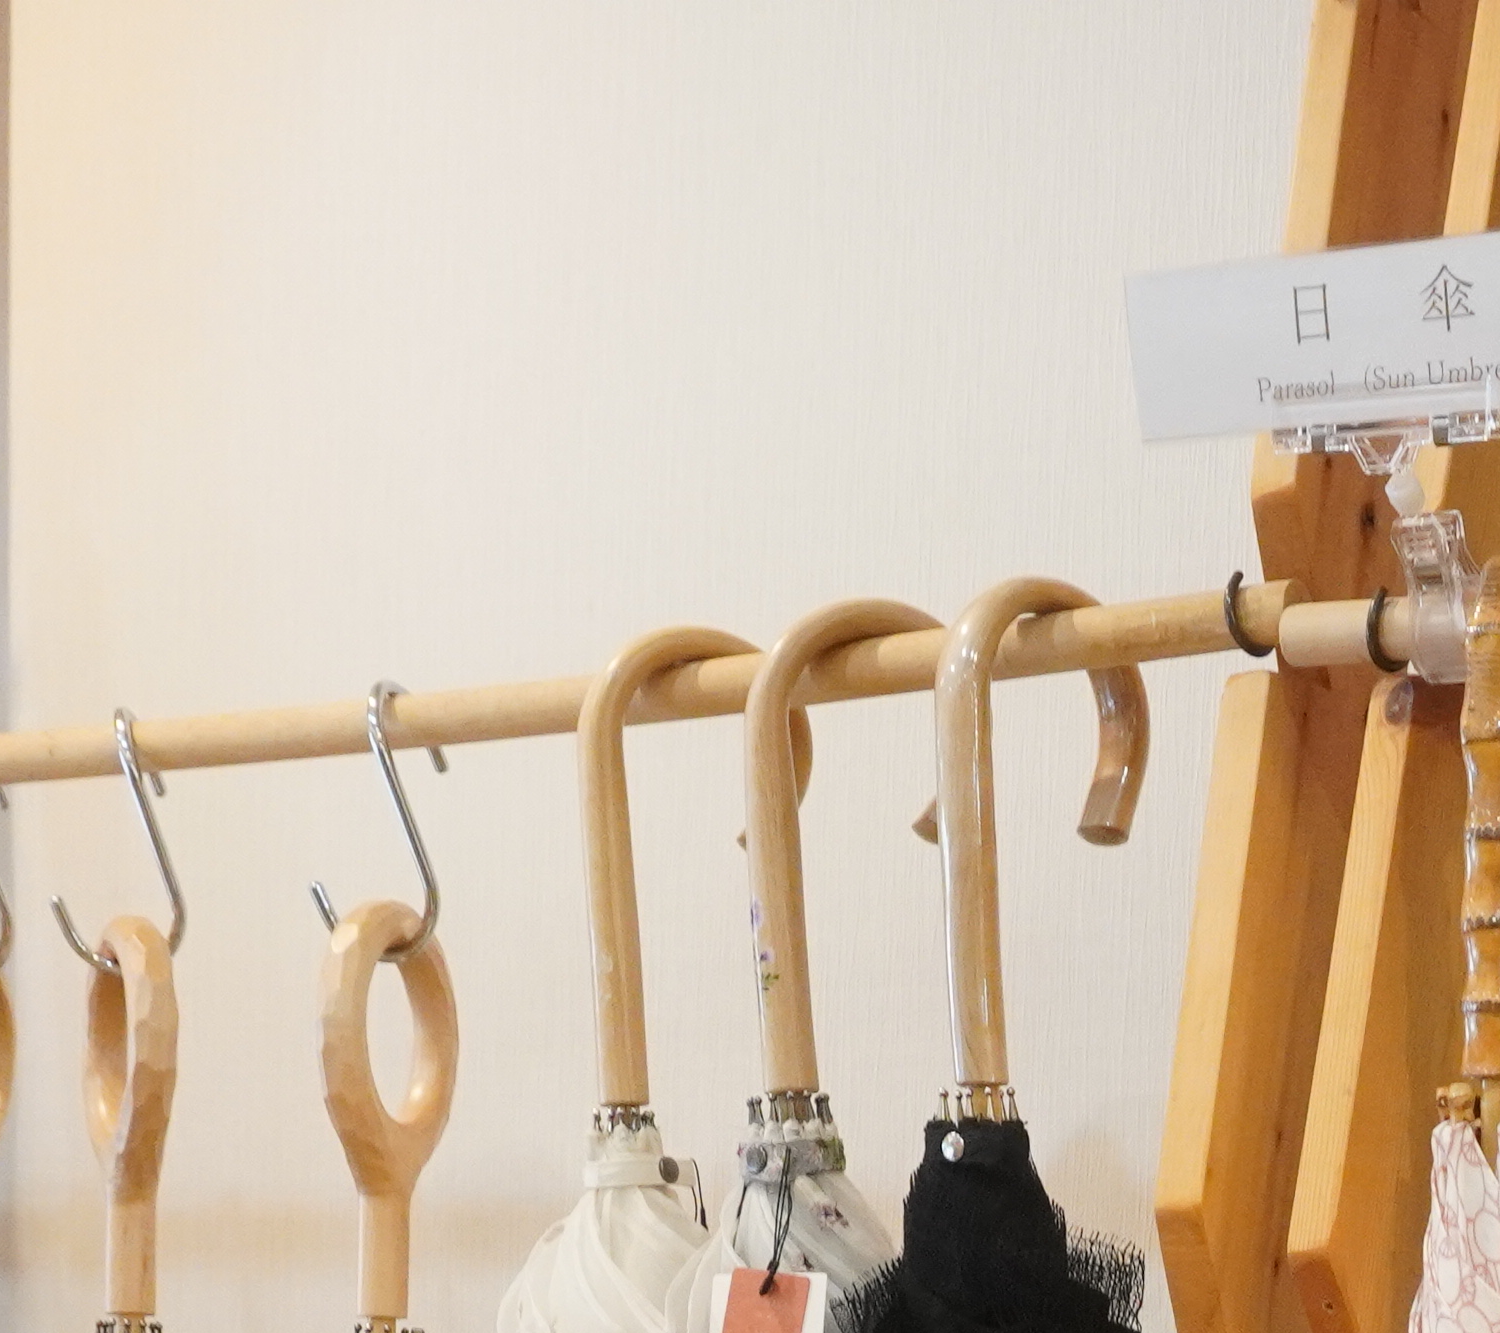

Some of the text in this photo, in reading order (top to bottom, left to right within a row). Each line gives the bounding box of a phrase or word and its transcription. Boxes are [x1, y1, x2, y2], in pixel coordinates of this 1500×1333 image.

[1292, 263, 1477, 345] 日傘
[1256, 370, 1337, 403] Parasol
[1363, 365, 1416, 393] (Sun
